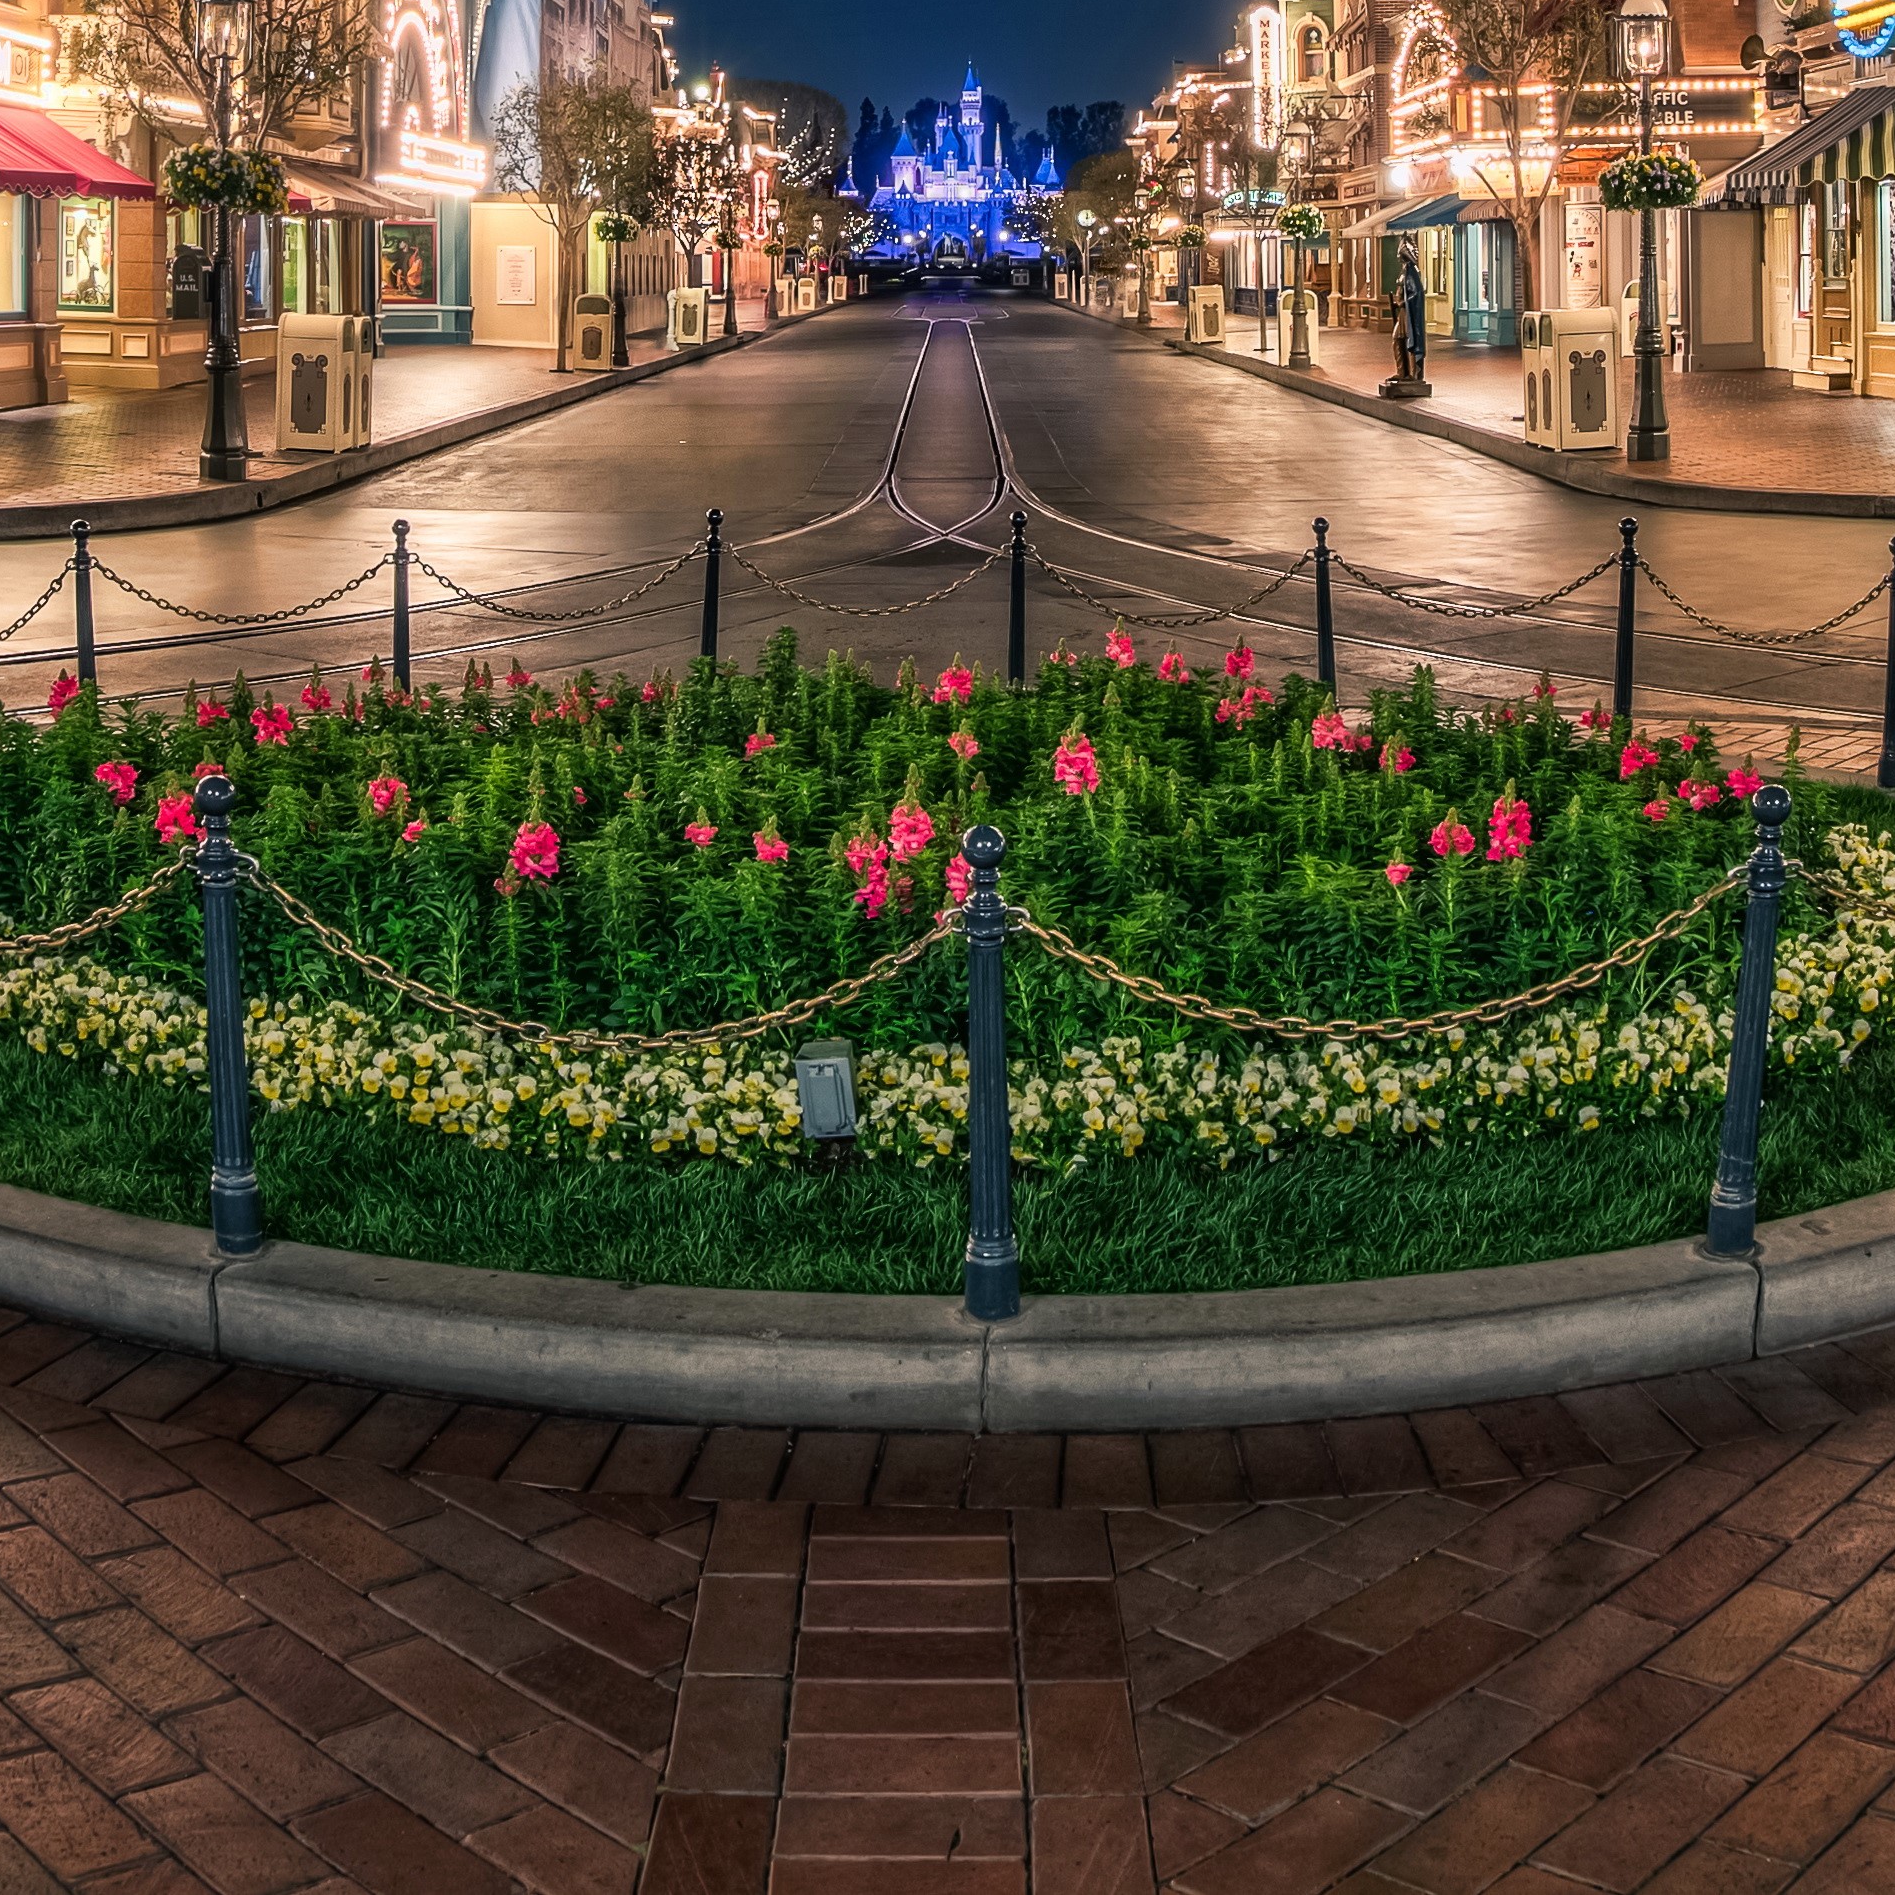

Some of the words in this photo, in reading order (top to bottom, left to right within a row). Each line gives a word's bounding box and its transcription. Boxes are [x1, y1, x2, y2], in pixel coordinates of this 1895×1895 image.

[1859, 22, 1881, 42] STREET
[1259, 19, 1271, 81] MARKET
[1619, 91, 1689, 106] TRFFIC
[1618, 110, 1695, 126] TRBLE
[176, 284, 198, 292] MAIL
